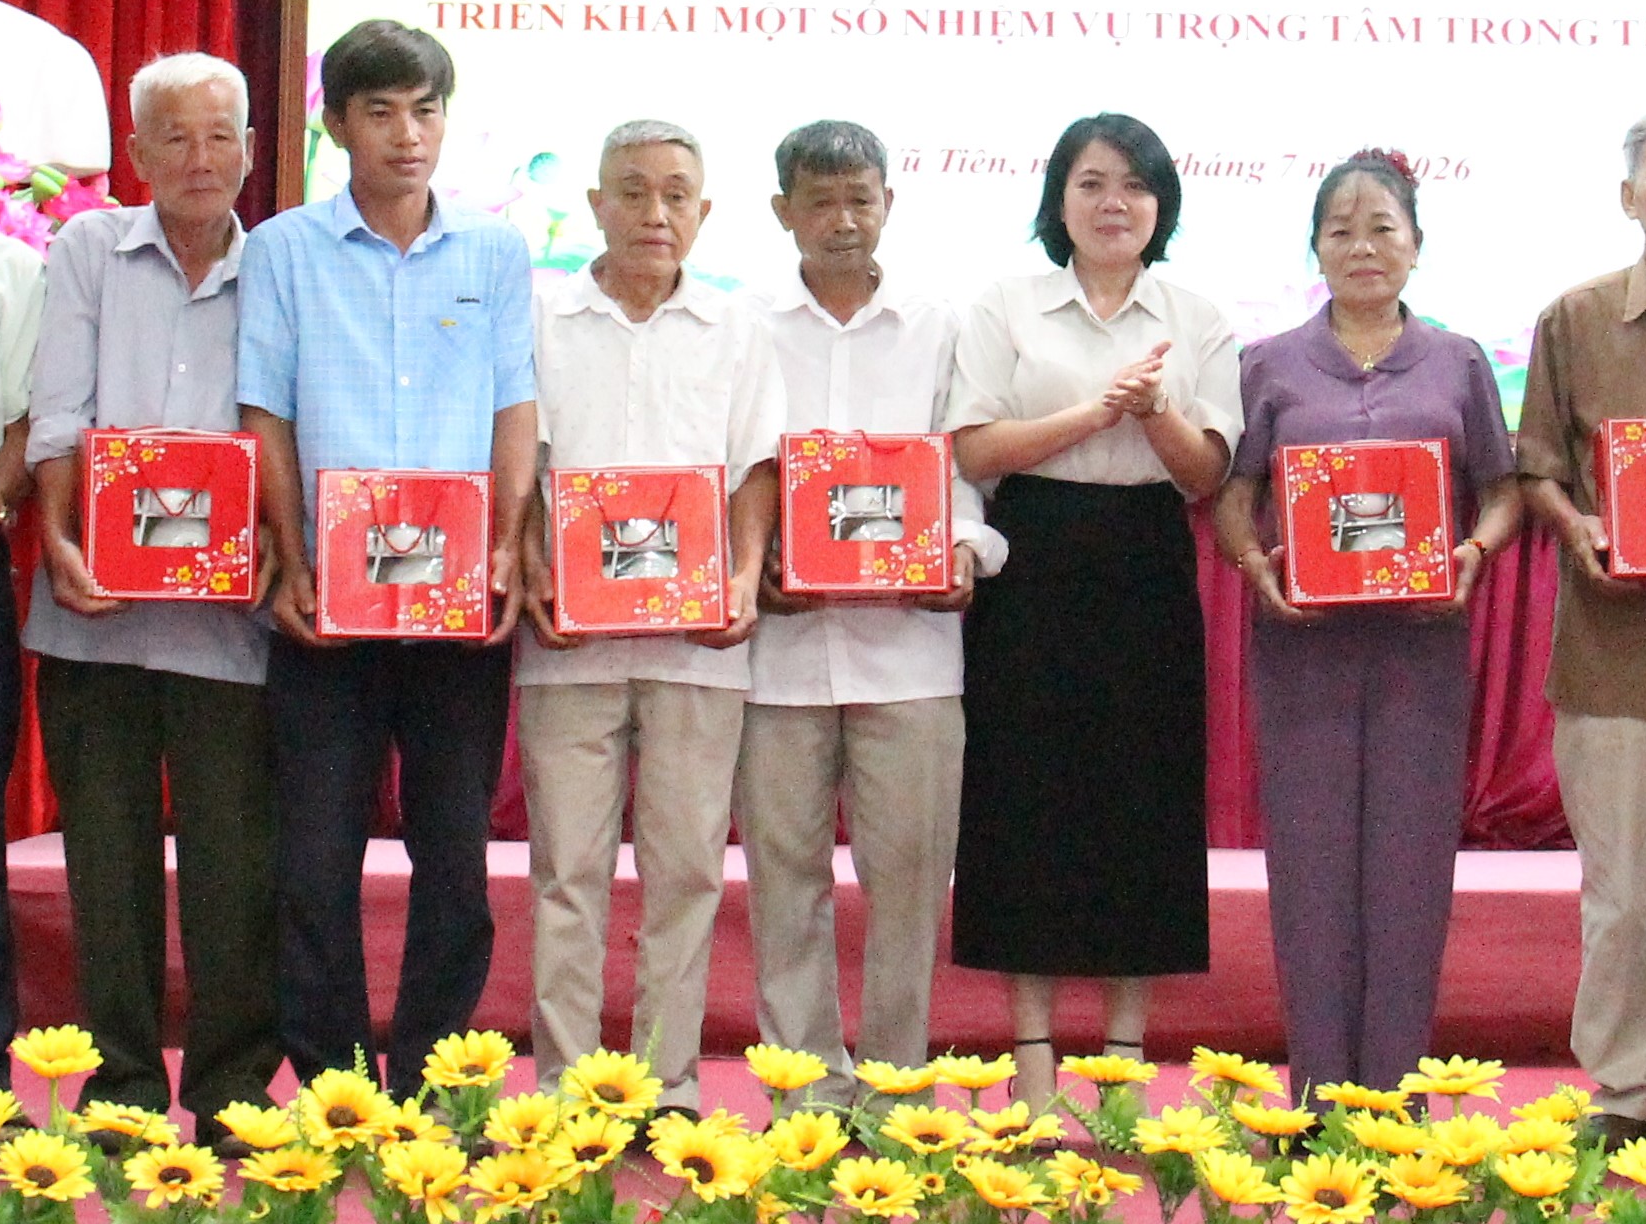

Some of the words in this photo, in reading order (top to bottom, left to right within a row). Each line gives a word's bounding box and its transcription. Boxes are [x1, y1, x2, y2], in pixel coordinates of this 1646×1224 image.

[583, 3, 696, 33] KHAI
[715, 2, 816, 41] MỘT
[905, 5, 1055, 45] NHIỆM
[1073, 12, 1130, 46] VỤ
[1146, 13, 1306, 48] TRỌNG
[1323, 8, 1422, 43] TÂM
[1438, 18, 1598, 46] TRONG
[939, 148, 1017, 176] Tiên,
[1280, 154, 1297, 177] 7
[1413, 156, 1471, 181] 026
